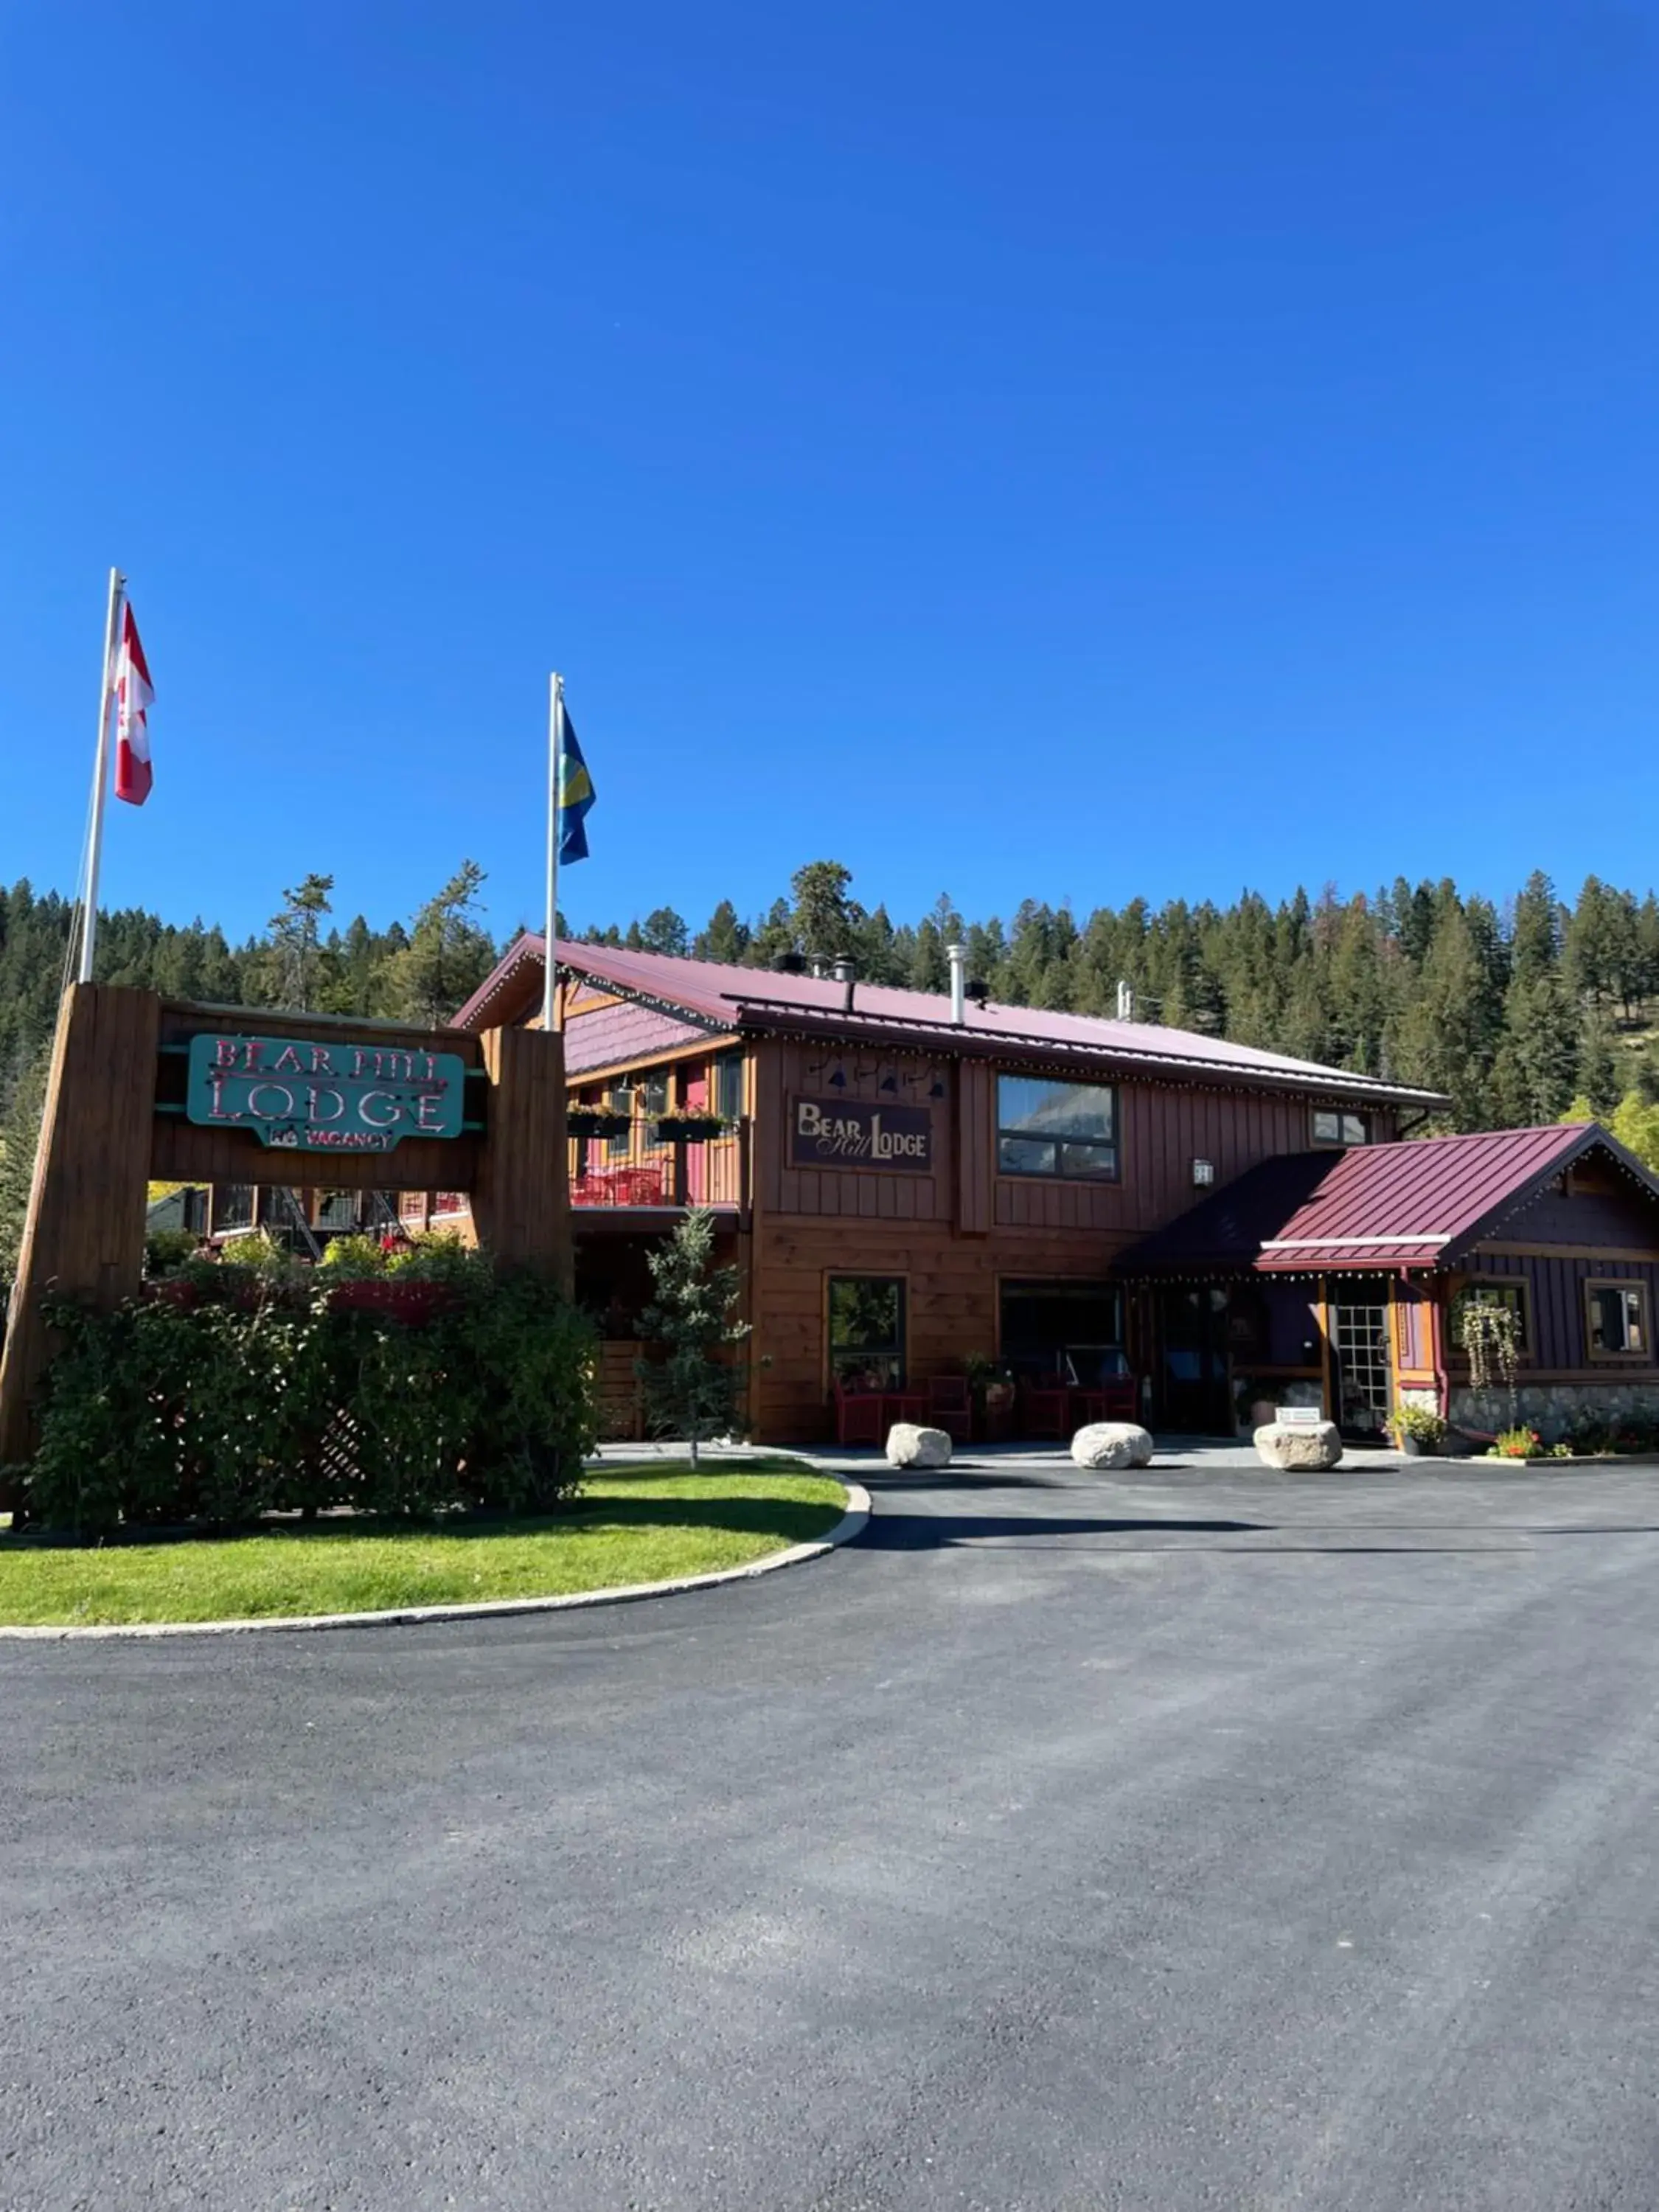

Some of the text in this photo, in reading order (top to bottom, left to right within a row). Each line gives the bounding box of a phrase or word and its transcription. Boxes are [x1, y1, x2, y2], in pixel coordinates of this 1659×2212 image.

[215, 1040, 447, 1084] BEAR HILL
[208, 1079, 445, 1133] LODGE
[305, 1129, 393, 1149] VACANCY
[798, 1102, 927, 1160] BEAR Hill LODGE
